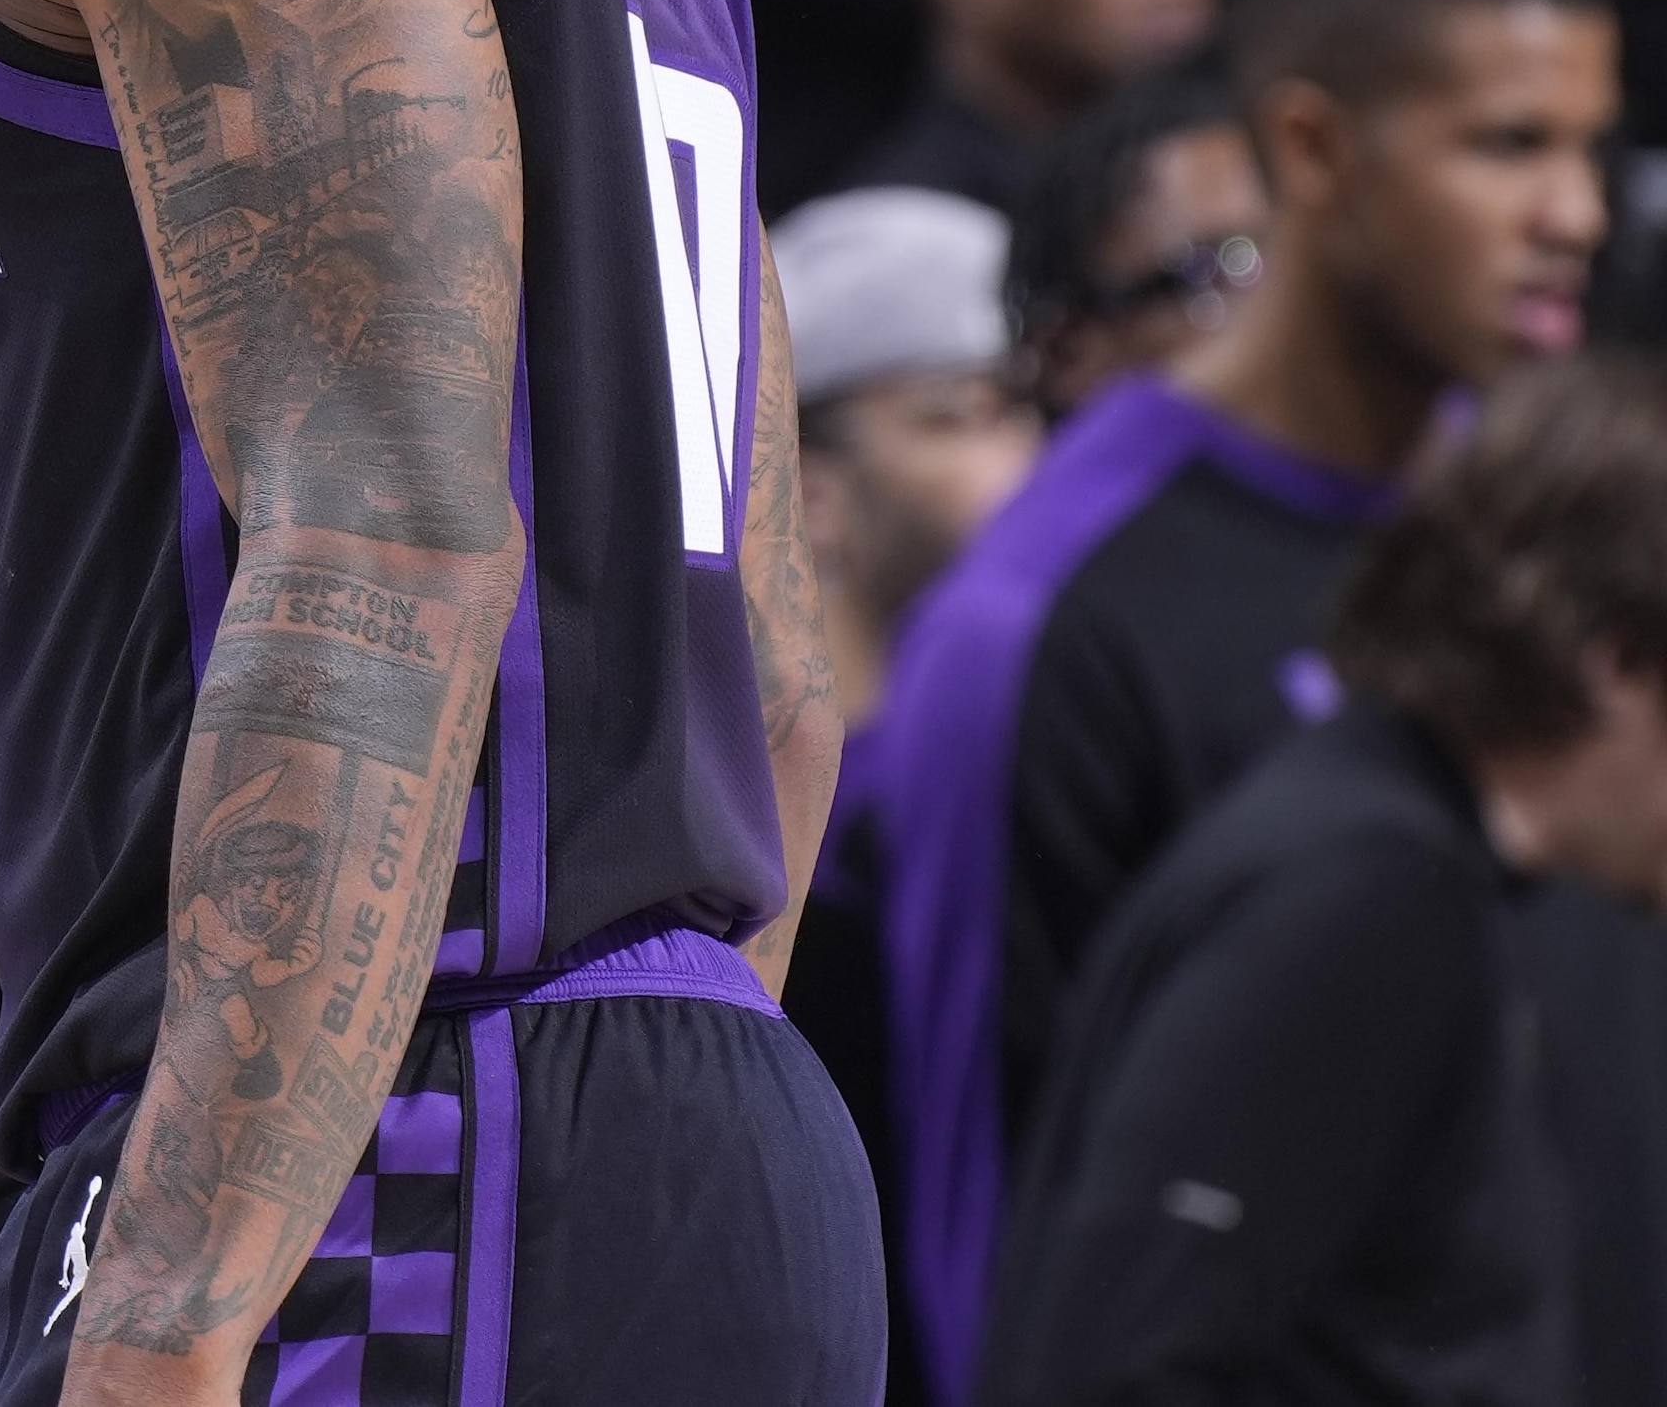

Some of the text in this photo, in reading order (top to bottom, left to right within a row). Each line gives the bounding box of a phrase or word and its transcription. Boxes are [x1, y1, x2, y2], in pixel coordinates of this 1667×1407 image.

[286, 597, 435, 661] SCHOOL
[322, 901, 386, 1036] BLUE
[370, 777, 415, 891] CITY
